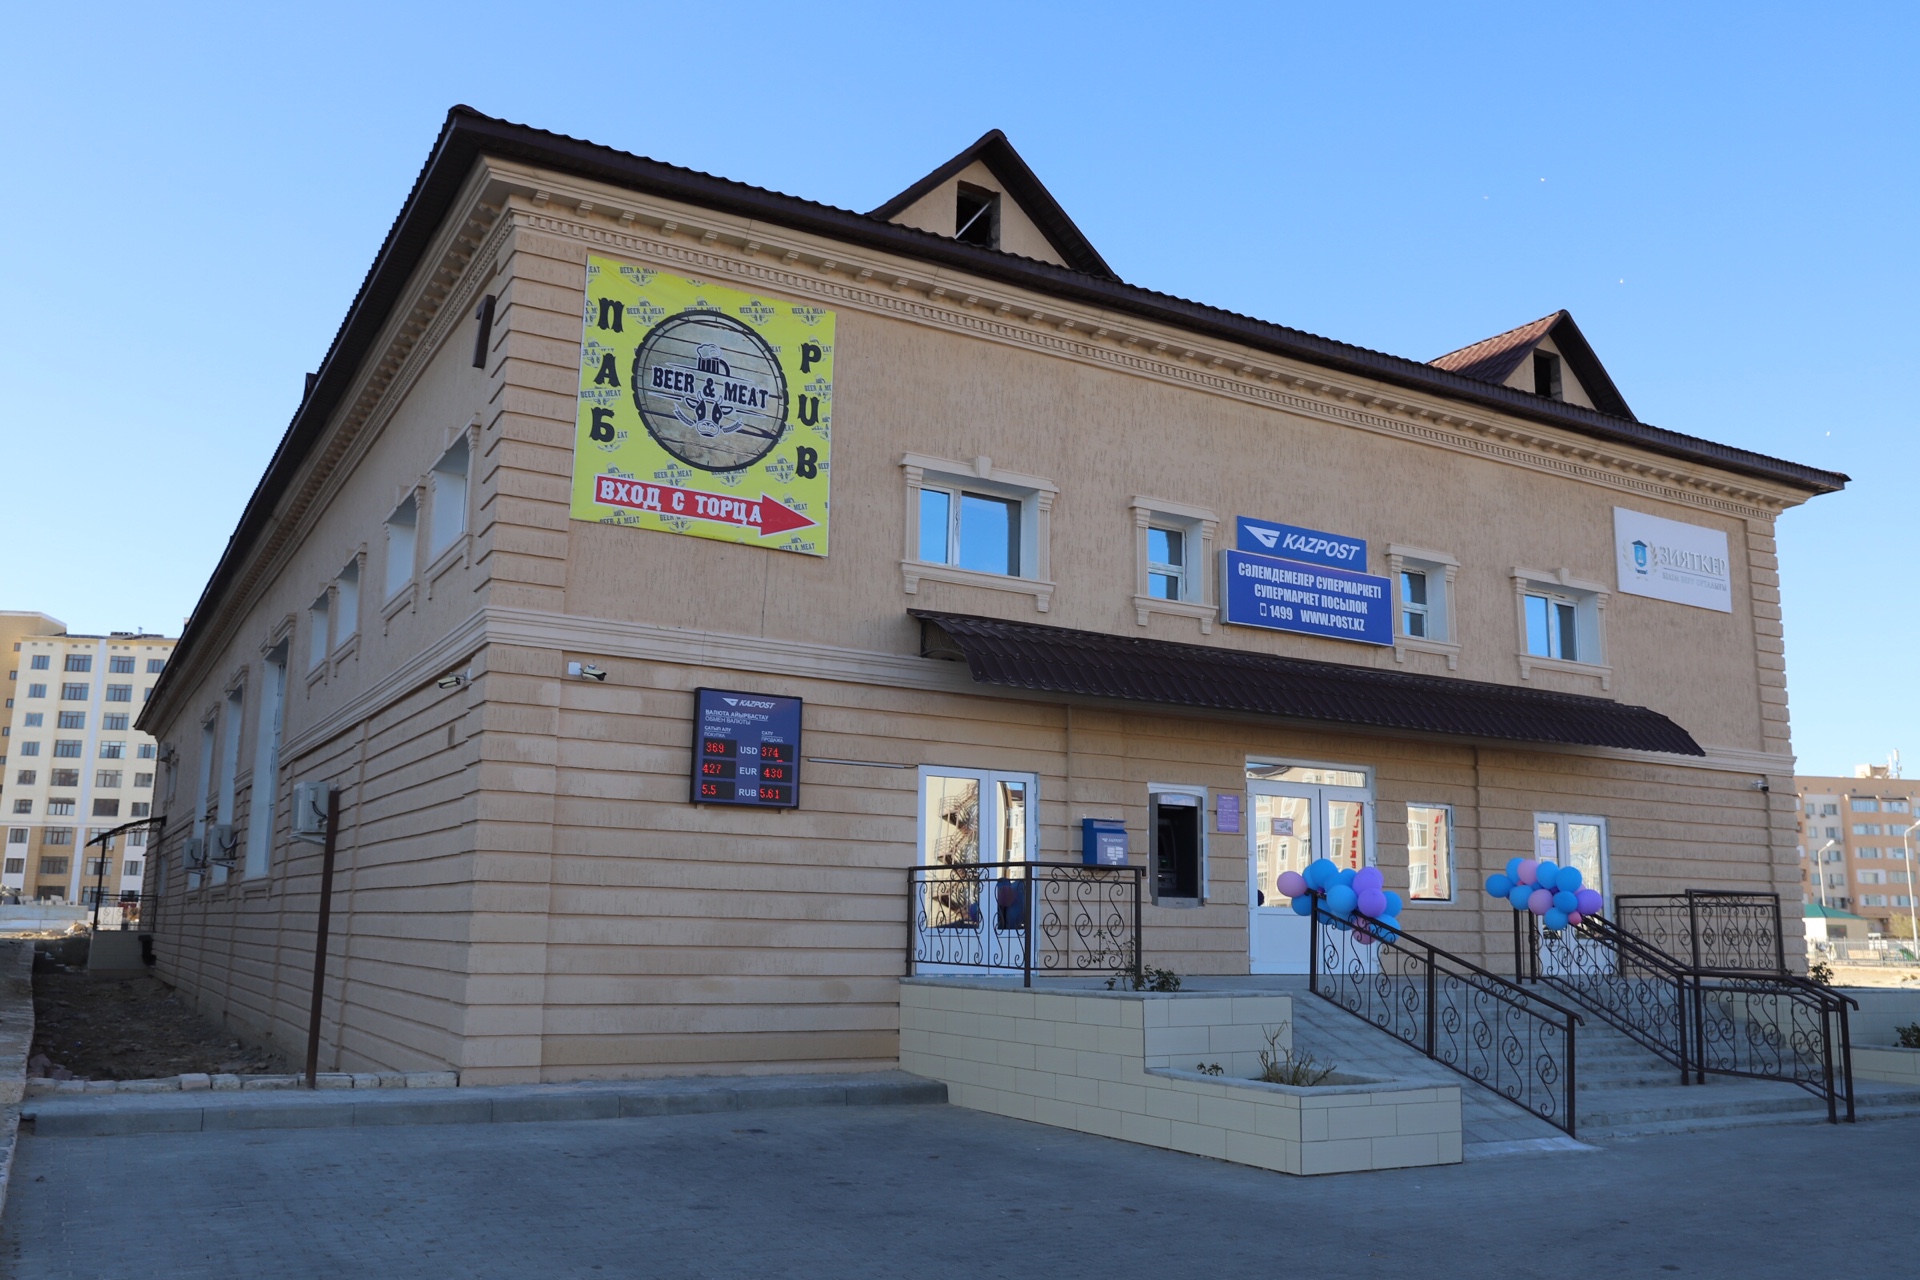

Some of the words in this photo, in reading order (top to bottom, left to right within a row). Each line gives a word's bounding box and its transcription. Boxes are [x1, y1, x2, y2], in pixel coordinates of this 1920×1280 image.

[626, 307, 640, 315] BEER
[650, 307, 665, 315] MEAT
[652, 366, 695, 394] BEER
[702, 377, 716, 398] &
[723, 382, 769, 409] MEAT
[804, 384, 817, 392] BEER
[581, 390, 595, 398] BEER
[606, 389, 621, 397] MEAT
[795, 343, 821, 479] PUB
[600, 479, 661, 512] ВХОД
[671, 492, 685, 511] С
[695, 495, 763, 526] ТОРЦА
[624, 516, 640, 524] MEAT
[801, 542, 815, 550] MEAT
[1282, 533, 1360, 561] KAZPOST
[1660, 546, 1726, 576] ЗИЯТКЕР
[1316, 575, 1382, 599] СУПЕРМАРКЕТІ
[1254, 583, 1319, 607] СУПЕРМАРКЕТ
[1321, 595, 1368, 615] ПОСЫЛОК
[1269, 604, 1293, 621] 1499
[1300, 609, 1365, 632] WWW.POST.KZ
[739, 699, 775, 709] KAZPOST
[705, 709, 729, 717] ВАЛЮТА
[730, 711, 769, 721] АЙЫРБАСТАУ
[705, 715, 726, 723] ОБМЕН
[726, 718, 751, 726] ВАЛЮТЫ
[706, 742, 725, 754] 369
[740, 746, 758, 755] USD
[761, 747, 779, 758] 374
[702, 763, 722, 774] 427
[739, 767, 757, 776] EUR
[702, 785, 717, 795] 5.5
[738, 788, 757, 797] RUB
